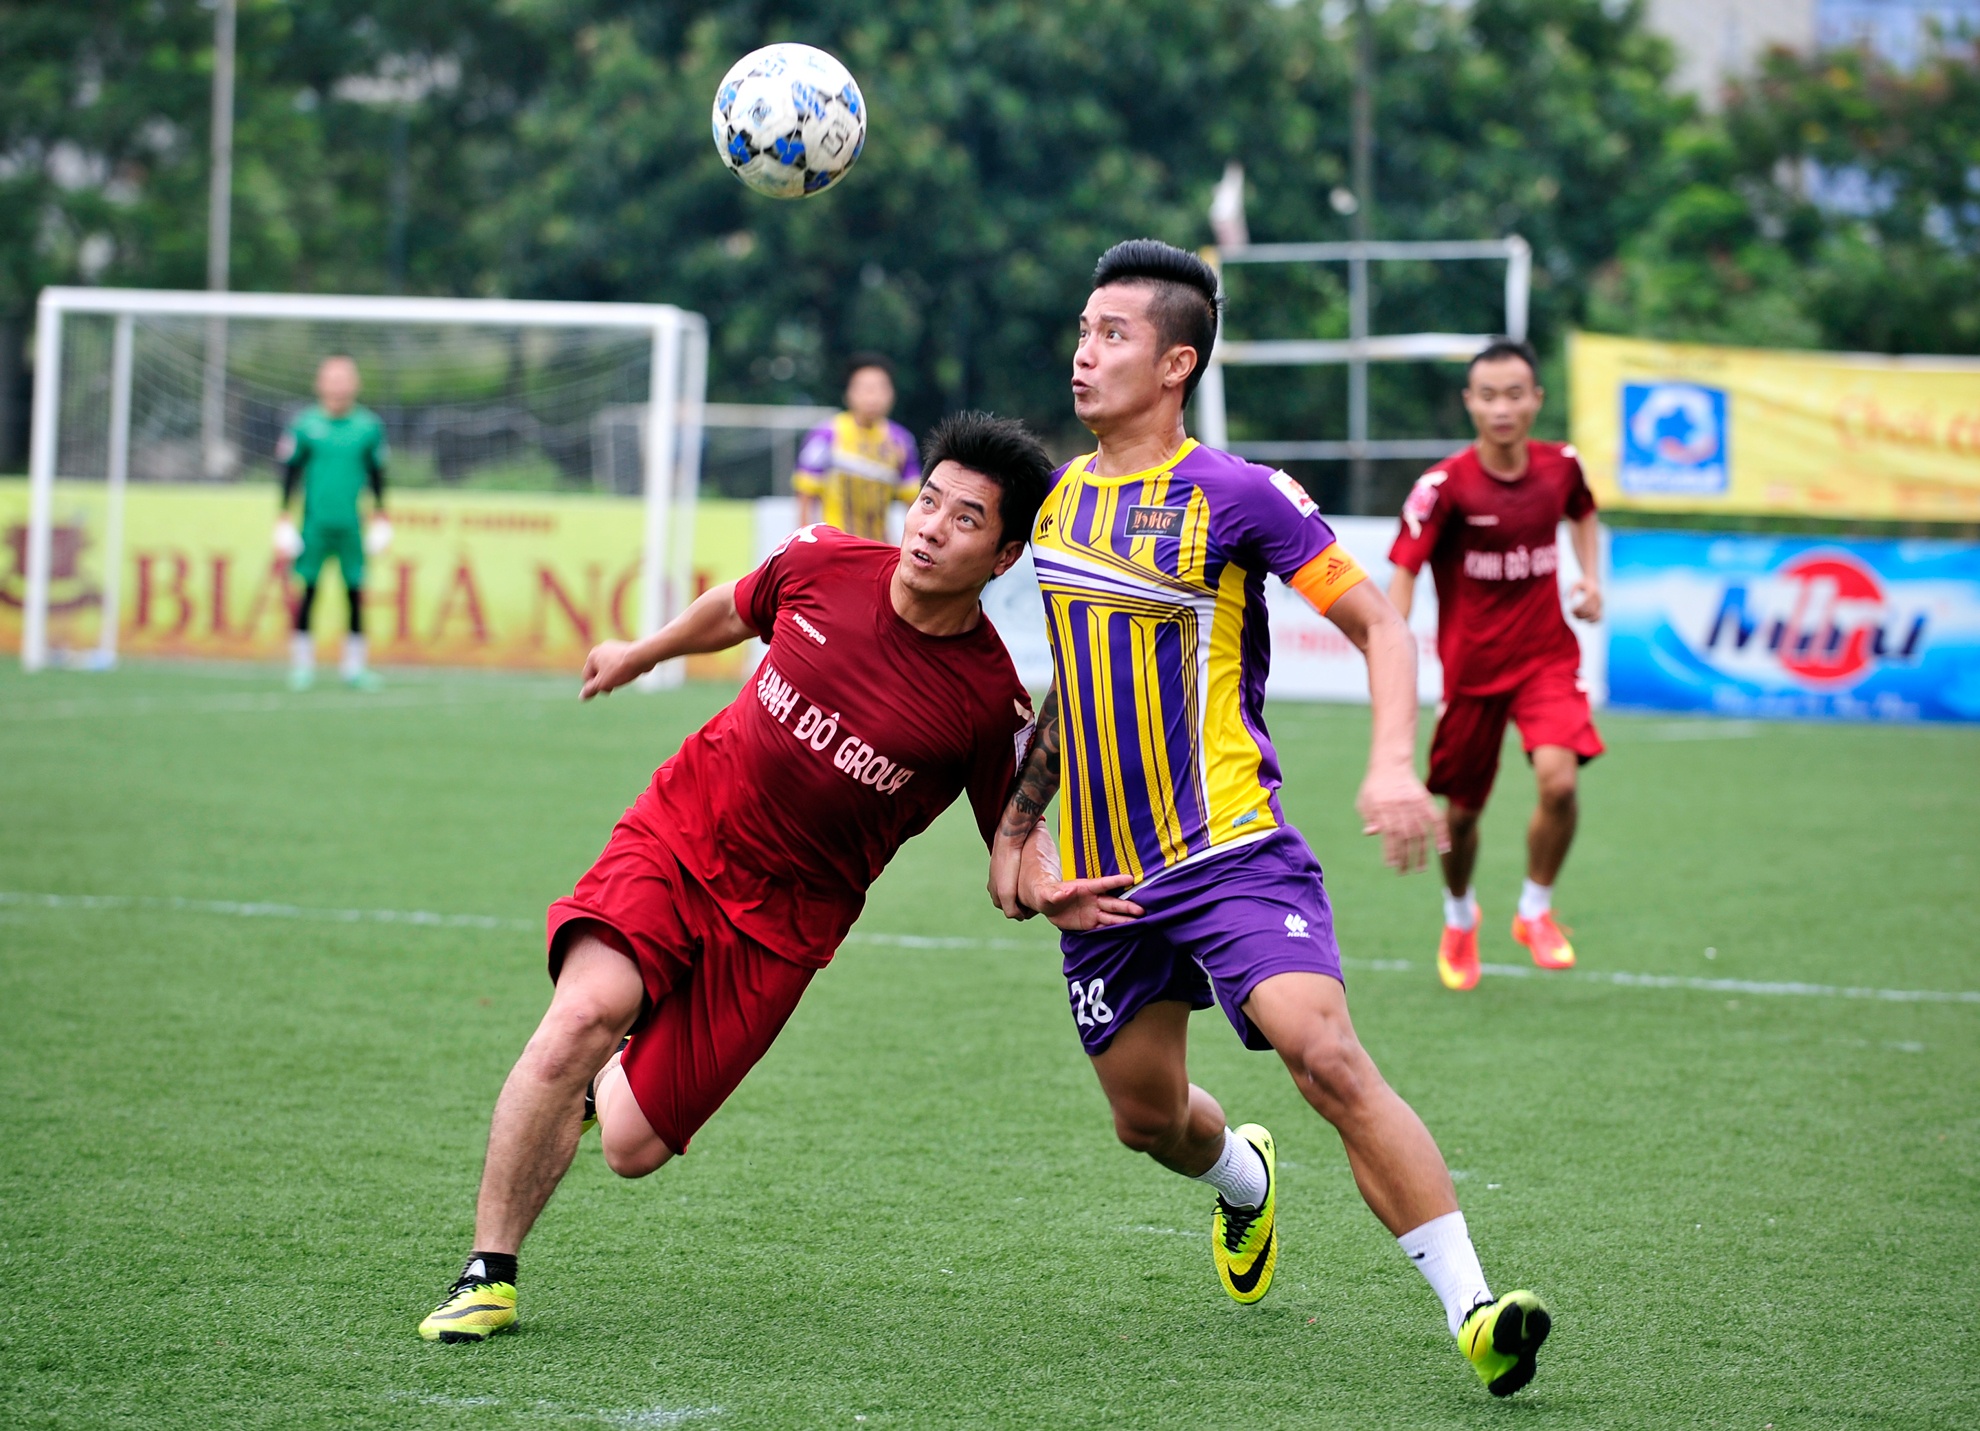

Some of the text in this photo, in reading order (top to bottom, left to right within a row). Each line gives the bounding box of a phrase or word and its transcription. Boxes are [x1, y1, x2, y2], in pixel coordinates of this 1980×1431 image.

[131, 552, 303, 638] BIA
[757, 662, 915, 796] KINH ĐÔ GROUP
[1071, 978, 1114, 1026] 28
